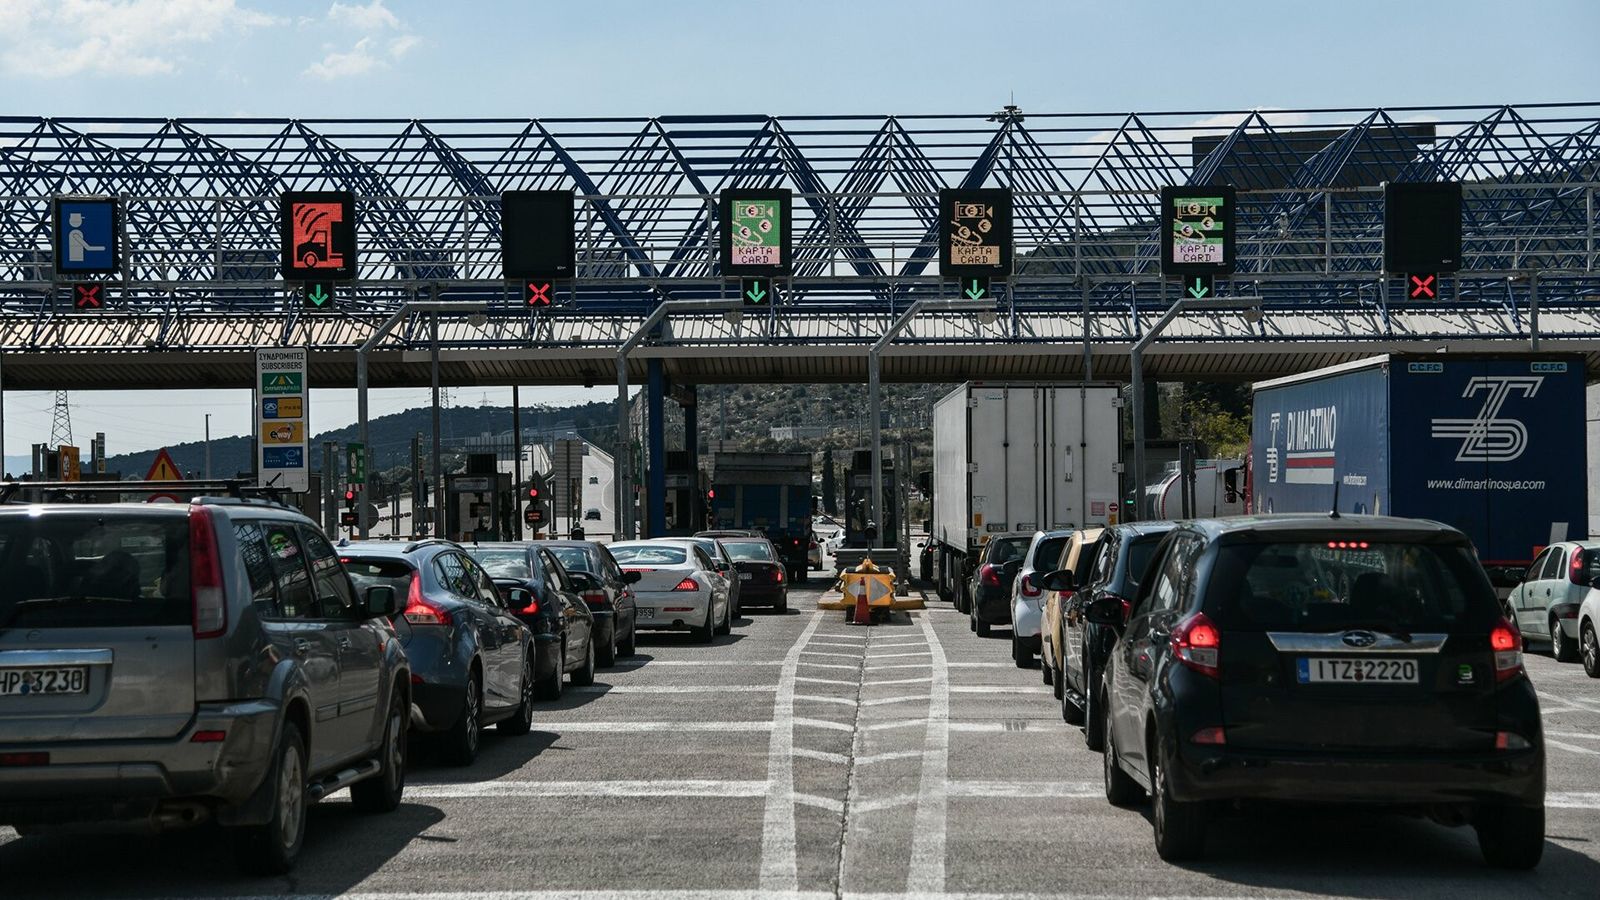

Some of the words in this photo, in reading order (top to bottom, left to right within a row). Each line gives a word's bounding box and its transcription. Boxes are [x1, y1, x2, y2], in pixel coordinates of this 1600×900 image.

[741, 255, 769, 264] CARD
[960, 255, 988, 264] CARD
[1183, 253, 1212, 262] CARD
[259, 352, 304, 361] ΣΥΝΔΡΟΜΗΤΕΣ
[261, 361, 303, 370] SUBSCRIBERS
[1286, 411, 1296, 451] DI
[1296, 405, 1337, 451] MARTINO
[1427, 478, 1546, 491] www.dimartinospa.com
[1364, 661, 1416, 681] 2220
